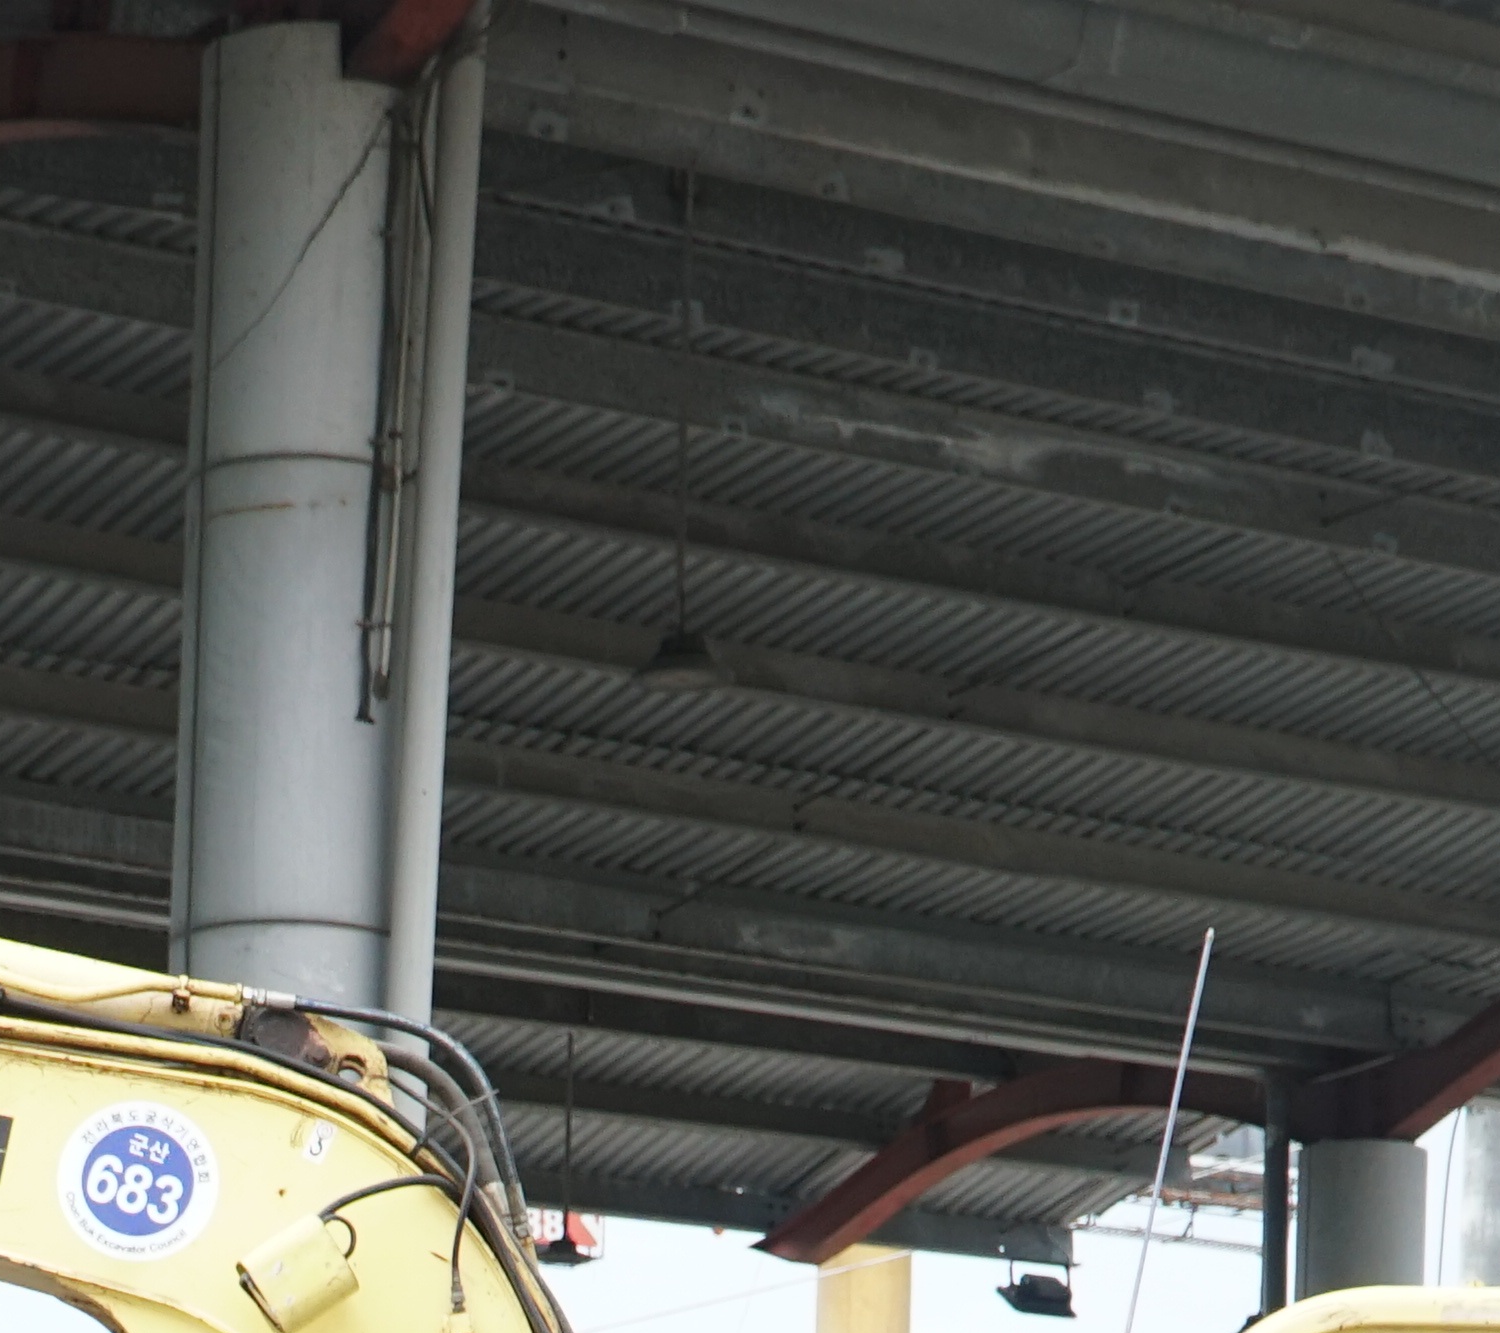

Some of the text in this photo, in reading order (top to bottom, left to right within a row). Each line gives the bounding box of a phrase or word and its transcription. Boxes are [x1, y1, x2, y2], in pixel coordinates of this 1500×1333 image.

[129, 1132, 170, 1164] 군산
[86, 1154, 184, 1225] 683
[96, 1233, 147, 1254] Excavator
[150, 1229, 187, 1252] Council
